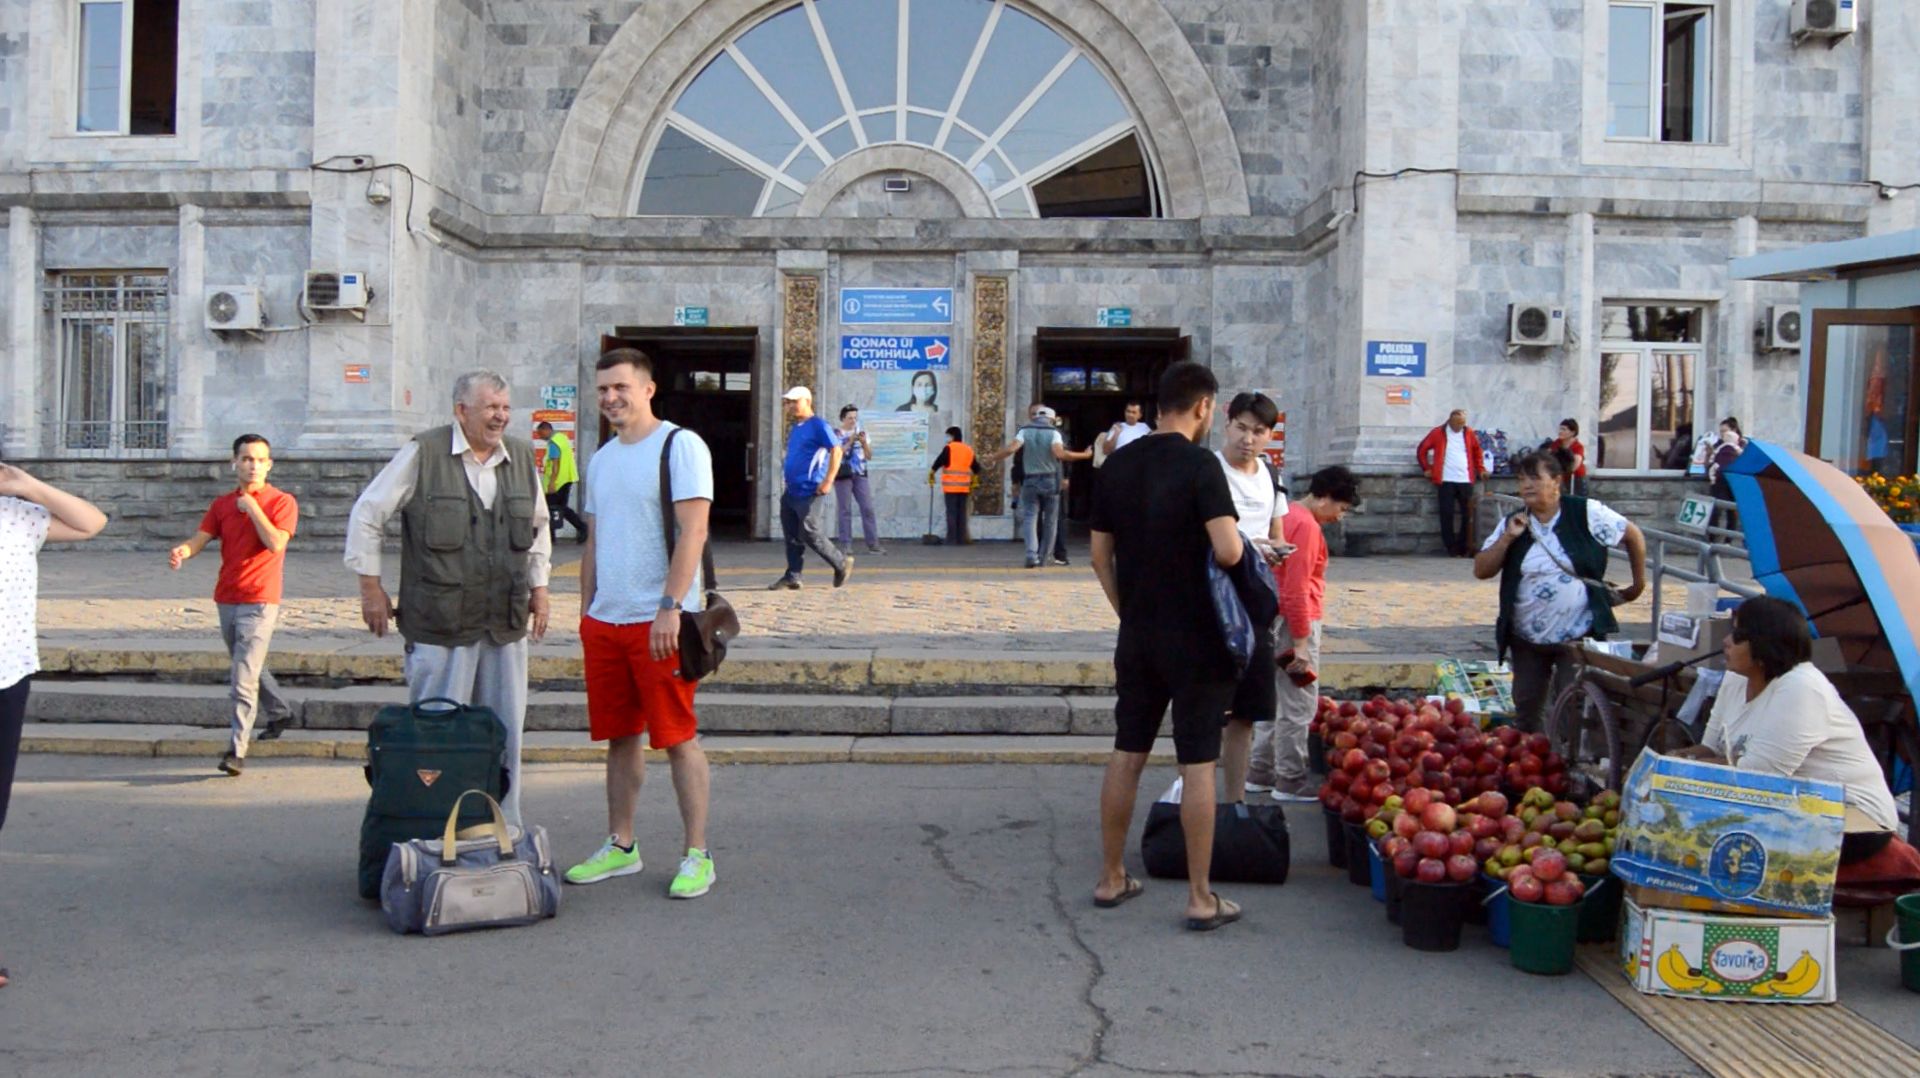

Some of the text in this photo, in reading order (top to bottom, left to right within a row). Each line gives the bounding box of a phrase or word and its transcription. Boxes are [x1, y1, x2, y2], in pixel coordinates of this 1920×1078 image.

[850, 338, 897, 348] QONAQ
[843, 349, 920, 360] ГОСТИНИЦА
[862, 360, 901, 369] HOTEL
[1646, 876, 1698, 892] PREMIUM
[1714, 949, 1766, 971] favorita
